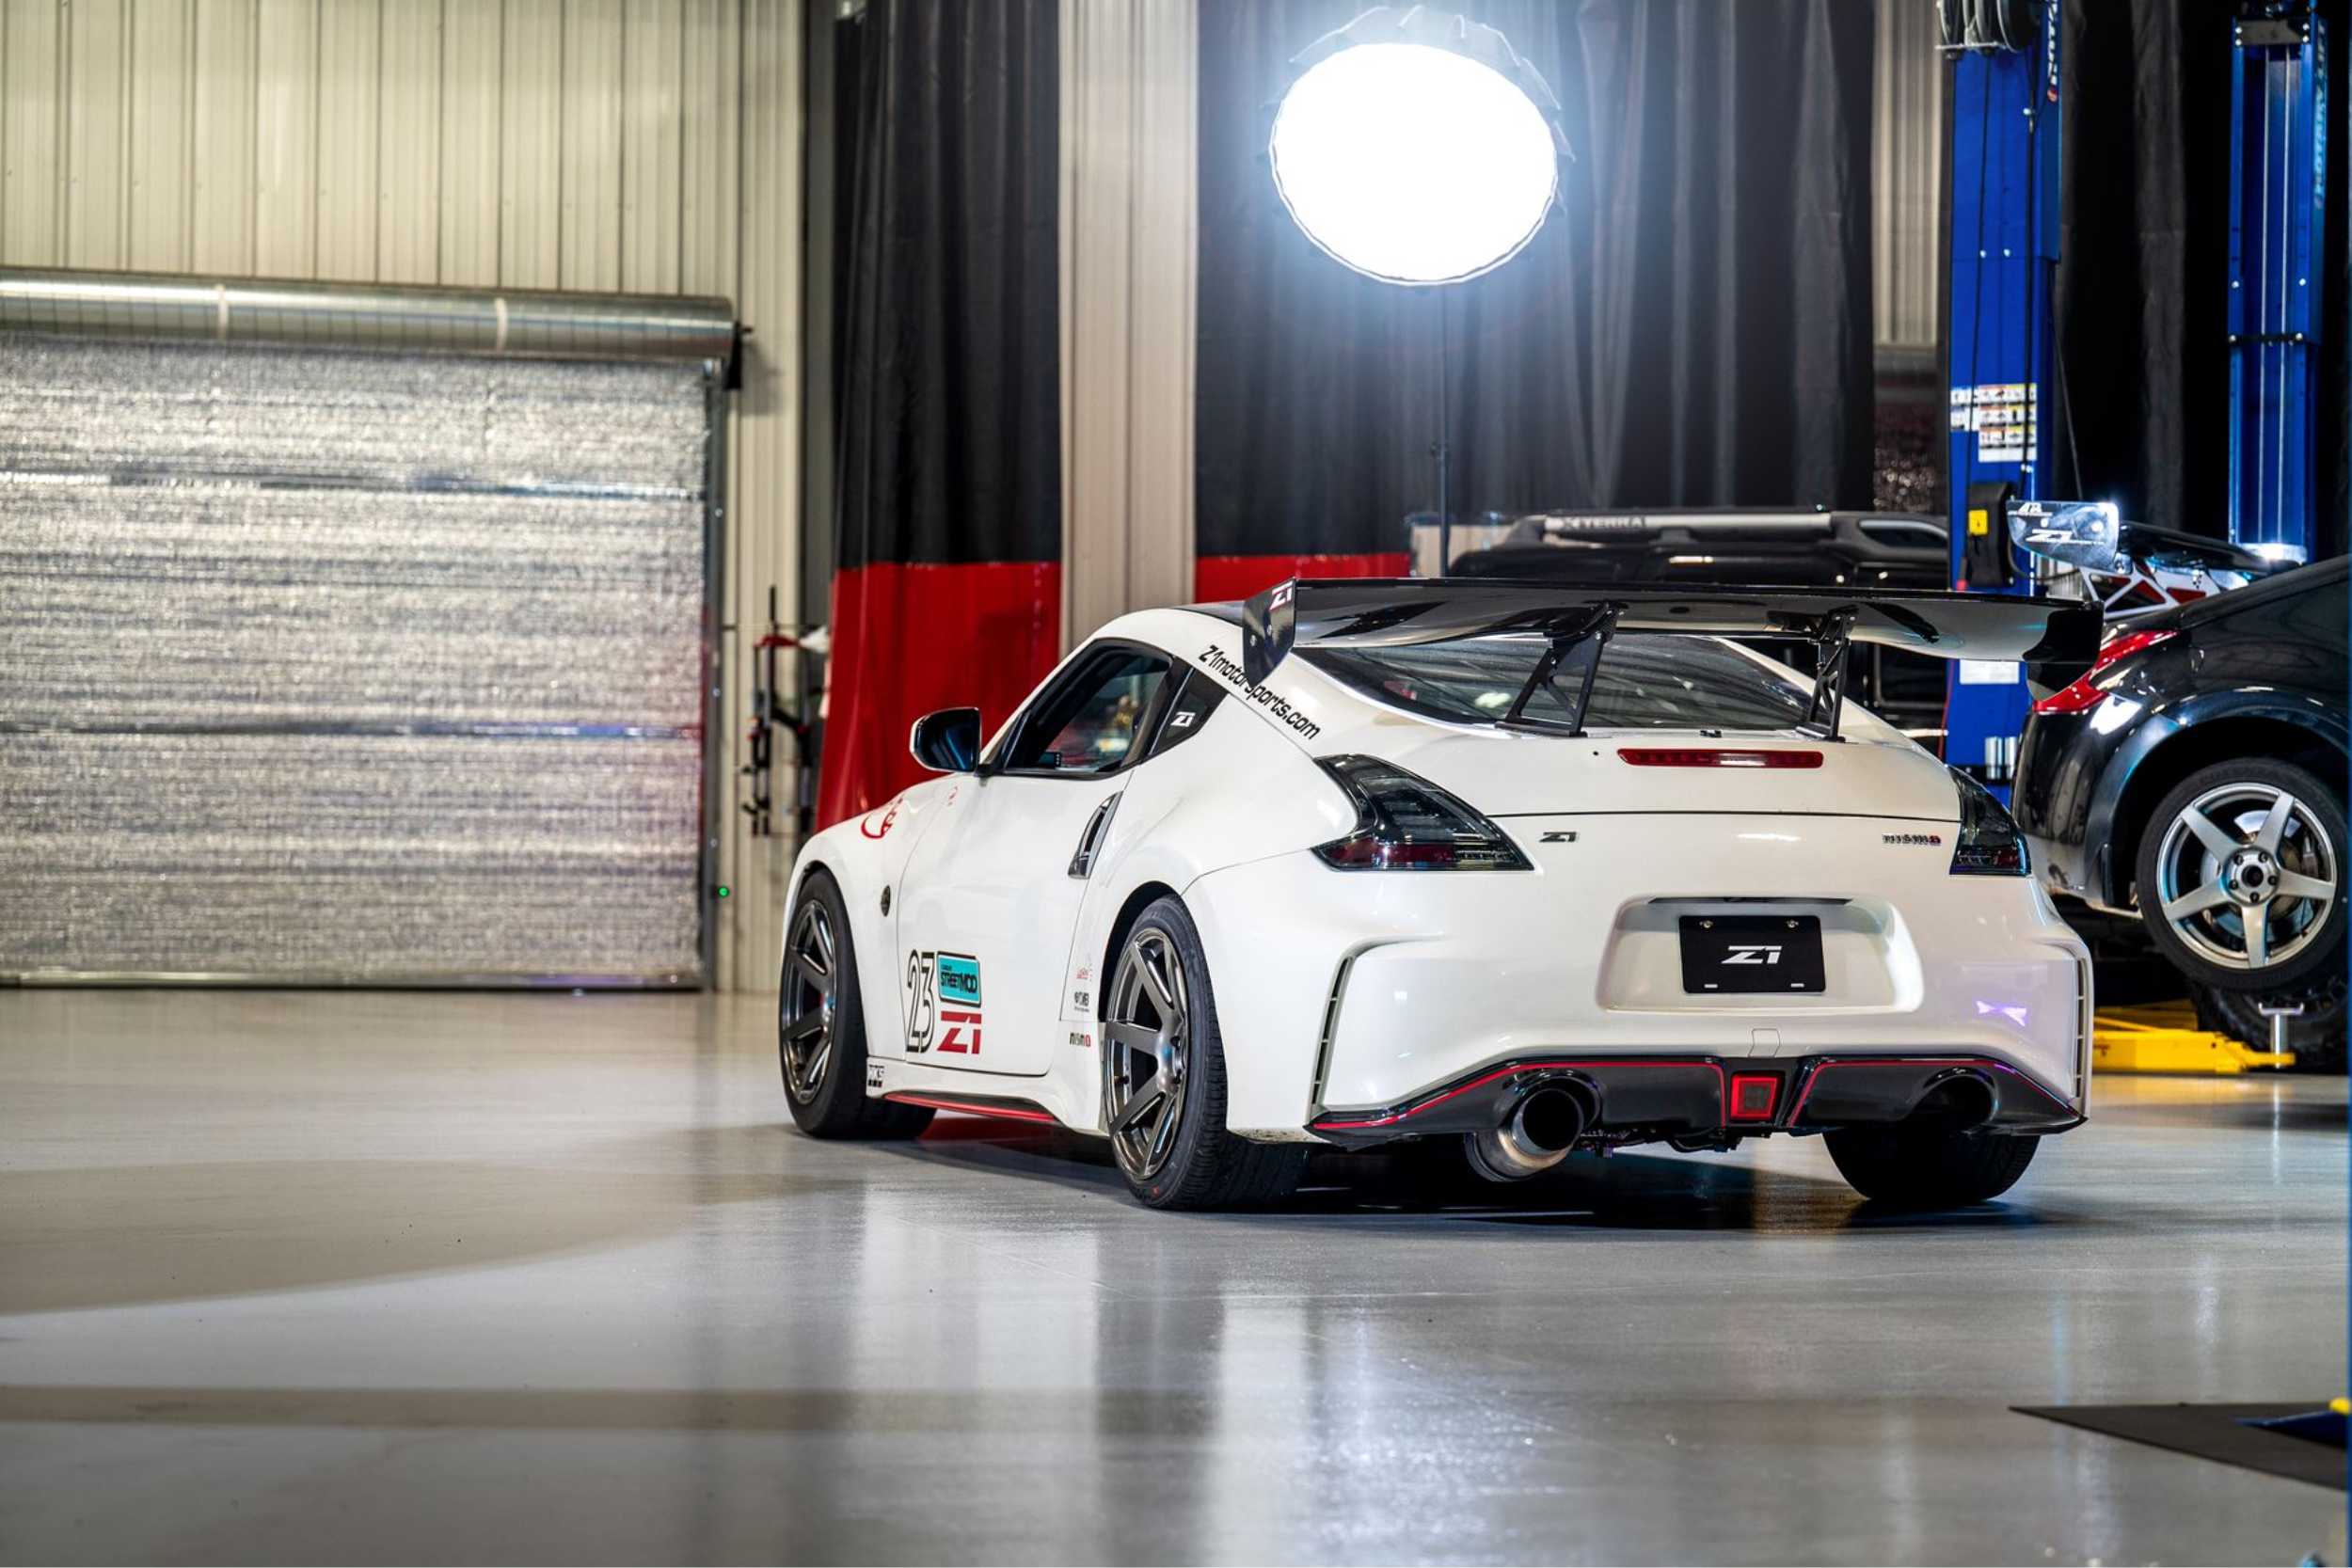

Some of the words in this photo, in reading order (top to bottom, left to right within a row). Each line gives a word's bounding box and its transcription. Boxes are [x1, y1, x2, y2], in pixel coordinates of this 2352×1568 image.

[1270, 580, 1293, 610] Z1
[1170, 711, 1196, 727] Z1
[1539, 832, 1577, 843] Z1
[1721, 945, 1782, 964] Z1
[906, 949, 935, 1053] 23
[937, 1011, 982, 1054] Z1
